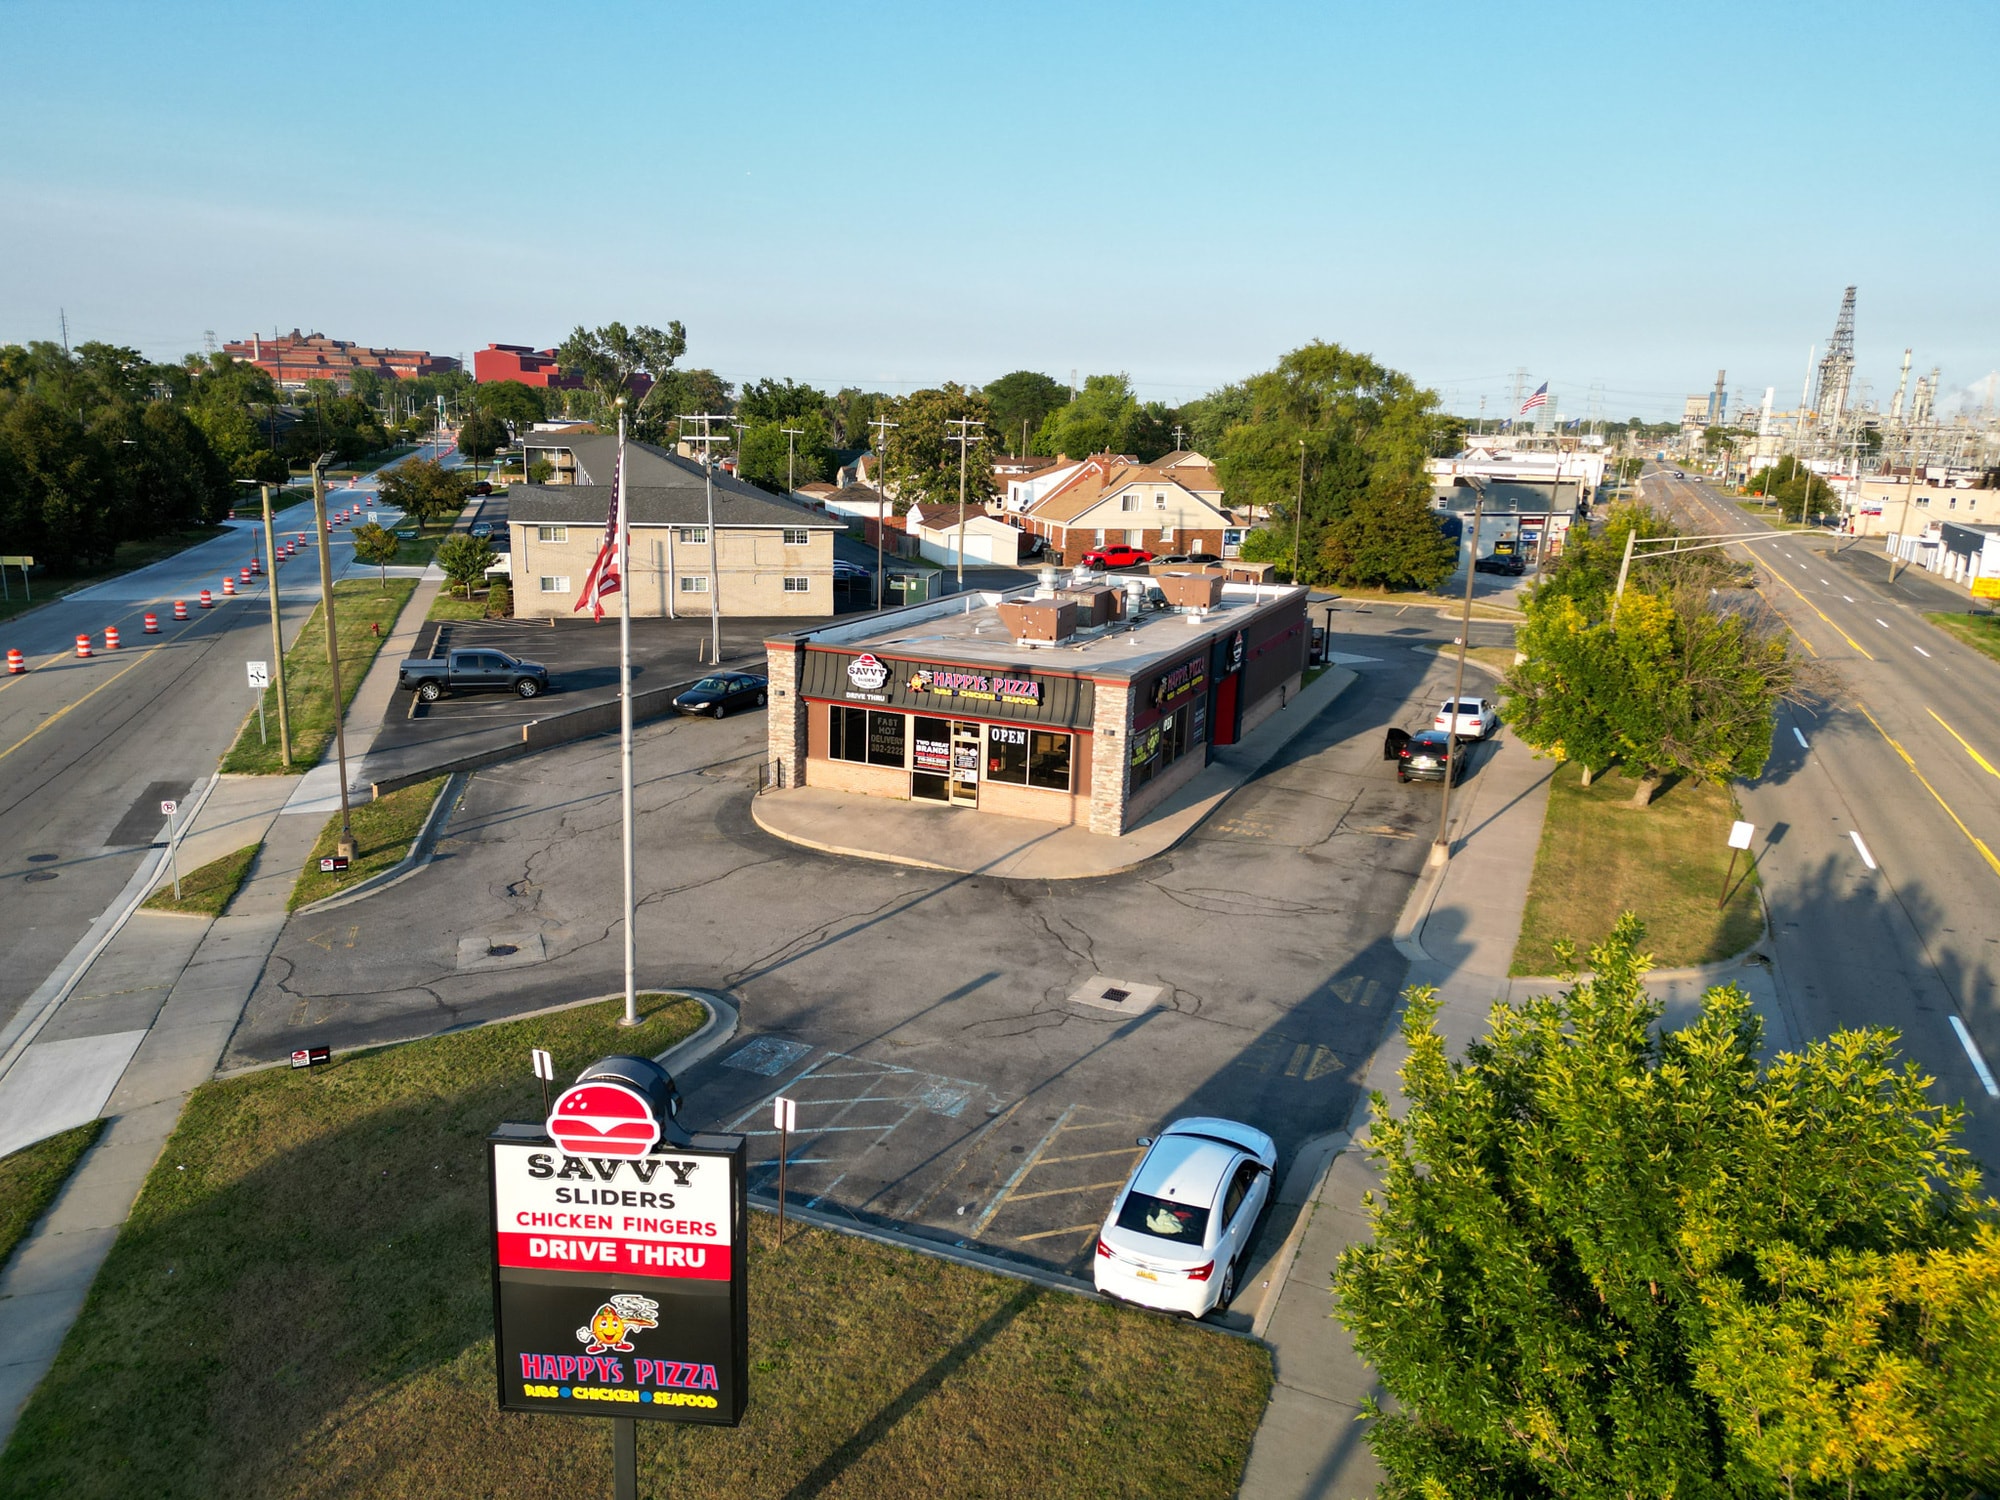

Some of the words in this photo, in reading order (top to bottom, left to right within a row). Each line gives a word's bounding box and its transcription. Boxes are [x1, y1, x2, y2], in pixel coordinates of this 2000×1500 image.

[849, 667, 885, 677] SAVVY
[993, 678, 1039, 697] PIZZA
[846, 692, 866, 700] DRIVE
[867, 694, 885, 702] THRU
[959, 690, 995, 701] CHICKEN
[1002, 695, 1038, 706] SEAFOOD
[877, 717, 898, 727] FAST
[879, 726, 897, 735] HOT
[992, 729, 1025, 744] OPEN
[871, 734, 904, 745] DELIVERY
[916, 739, 930, 747] TWO
[930, 741, 949, 749] GREAT
[916, 745, 949, 755] BRANDS
[528, 1153, 699, 1188] SAVVY
[556, 1188, 676, 1209] SLIDERS
[516, 1212, 613, 1230] CHICKEN
[623, 1217, 717, 1237] FINGERS
[529, 1238, 617, 1262] DRIVE
[625, 1243, 706, 1268] THRU
[634, 1358, 719, 1390] PIZZA
[523, 1384, 559, 1398] RIBS
[572, 1387, 640, 1403] CHICKEN
[652, 1391, 718, 1409] SEAFOOD
